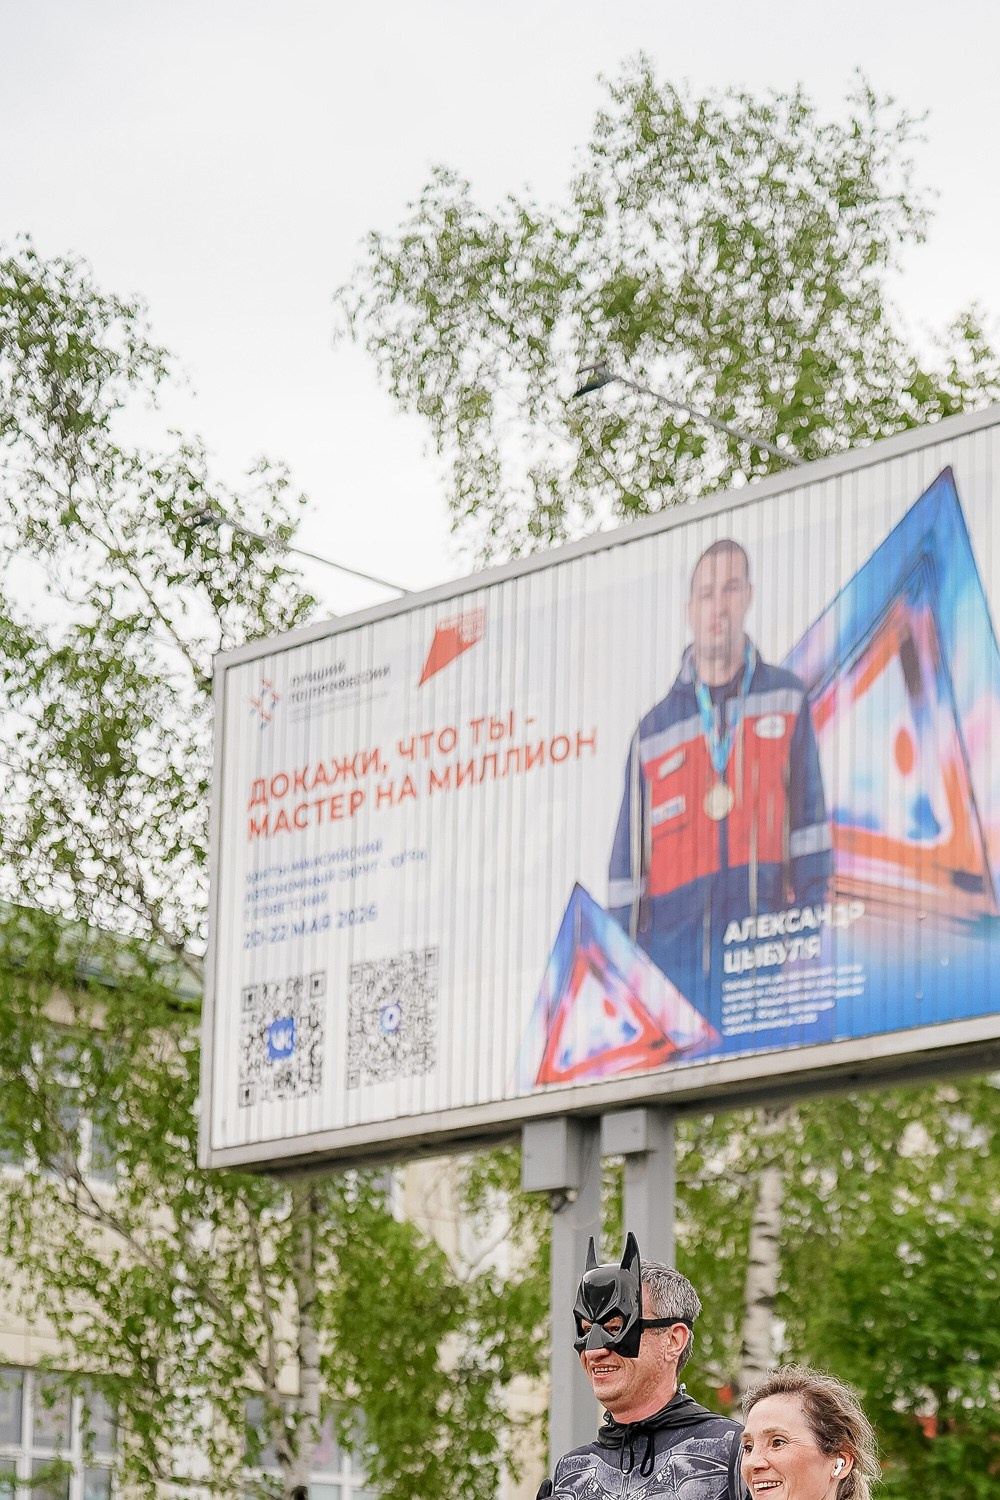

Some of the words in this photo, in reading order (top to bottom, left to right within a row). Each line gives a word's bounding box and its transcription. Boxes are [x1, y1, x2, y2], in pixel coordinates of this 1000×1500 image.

[248, 748, 388, 810] ДОКАЖИ,
[398, 727, 457, 761] ЧТО
[469, 709, 514, 745] ТЫ
[248, 790, 365, 842] МАСТЕР
[376, 774, 417, 811] НА
[429, 727, 598, 795] МИЛЛИОН
